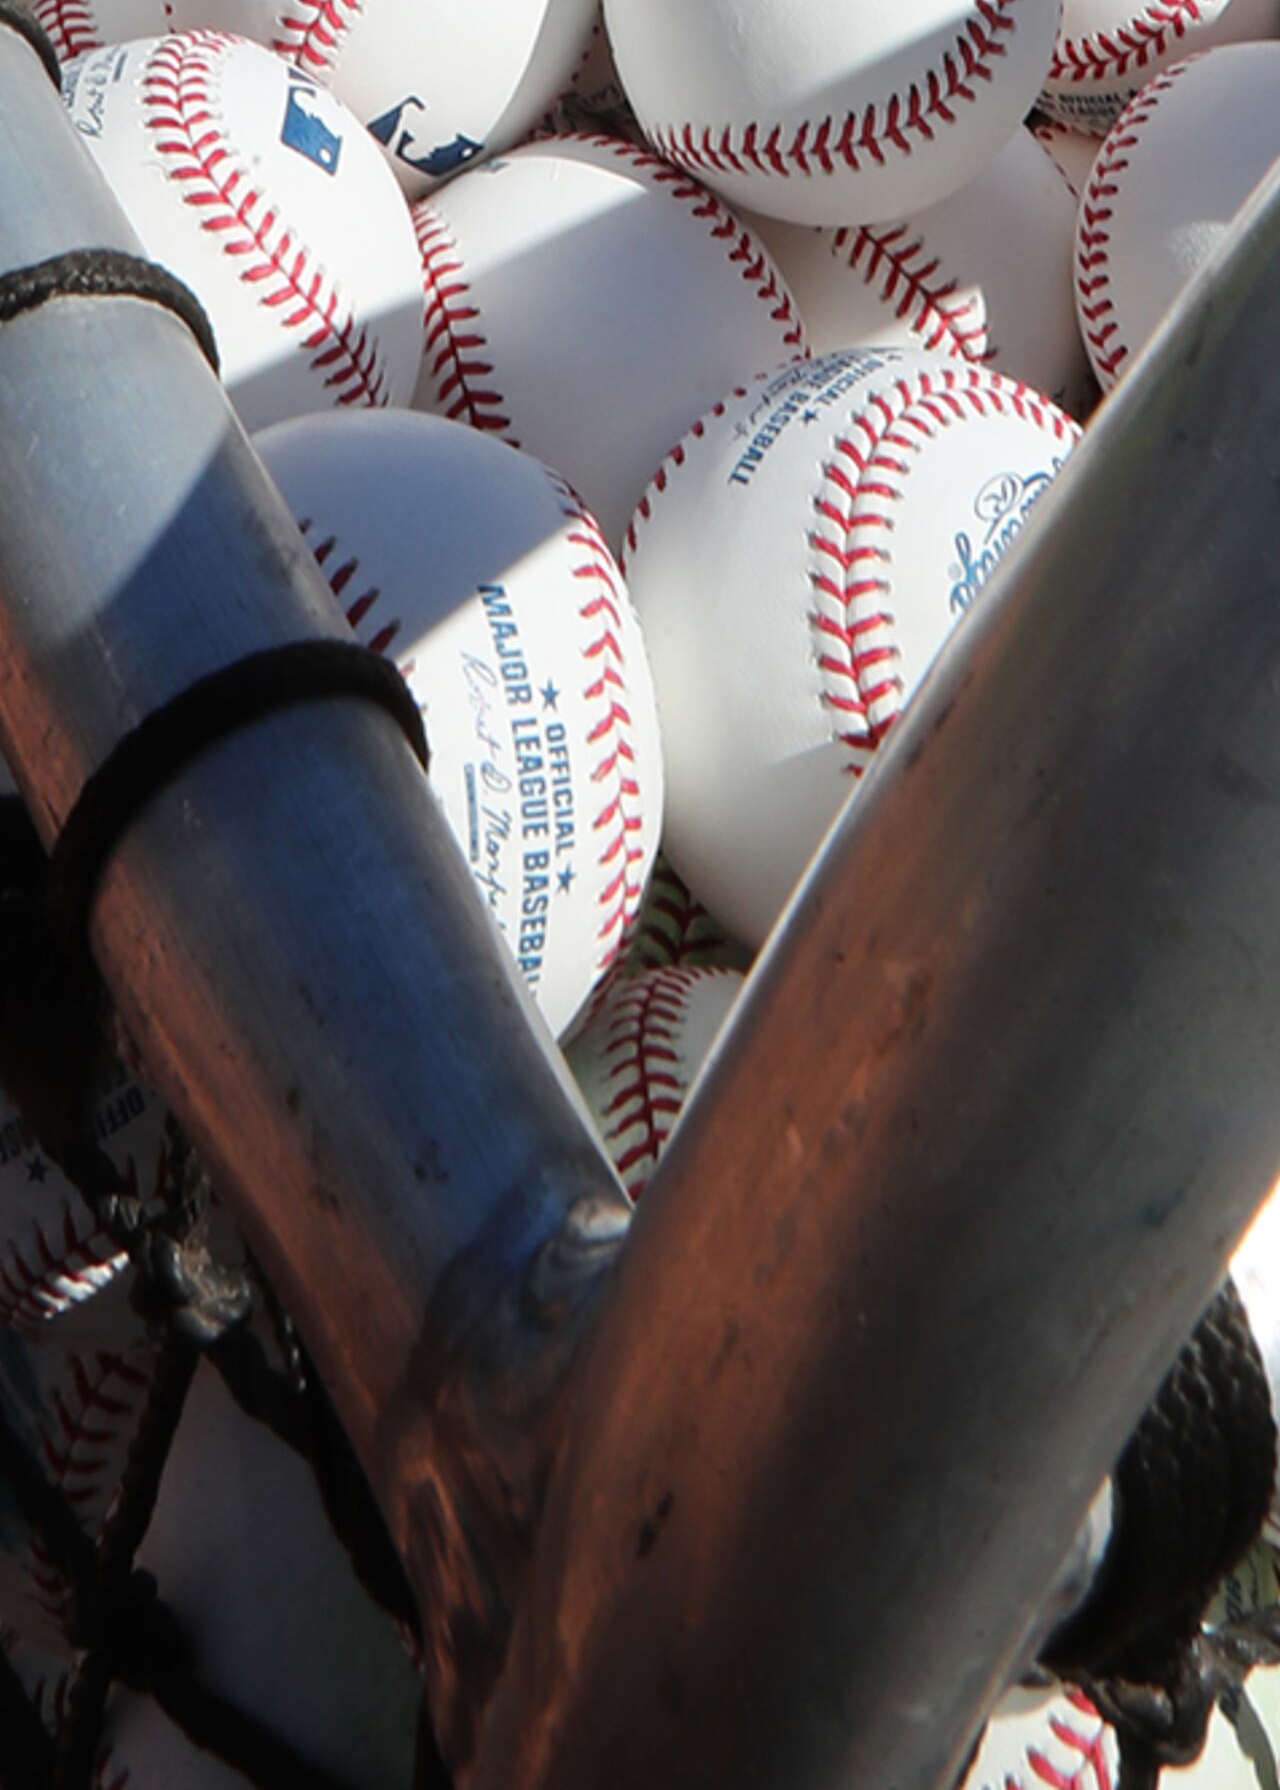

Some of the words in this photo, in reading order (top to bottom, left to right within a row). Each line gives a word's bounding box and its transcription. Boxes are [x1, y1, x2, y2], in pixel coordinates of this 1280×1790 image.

[726, 389, 811, 486] BASEBALL
[814, 356, 885, 406] OFFICIAL
[477, 582, 533, 705] MAJOR
[512, 717, 551, 841] LEAGUE
[544, 722, 575, 857] OFFICIAL
